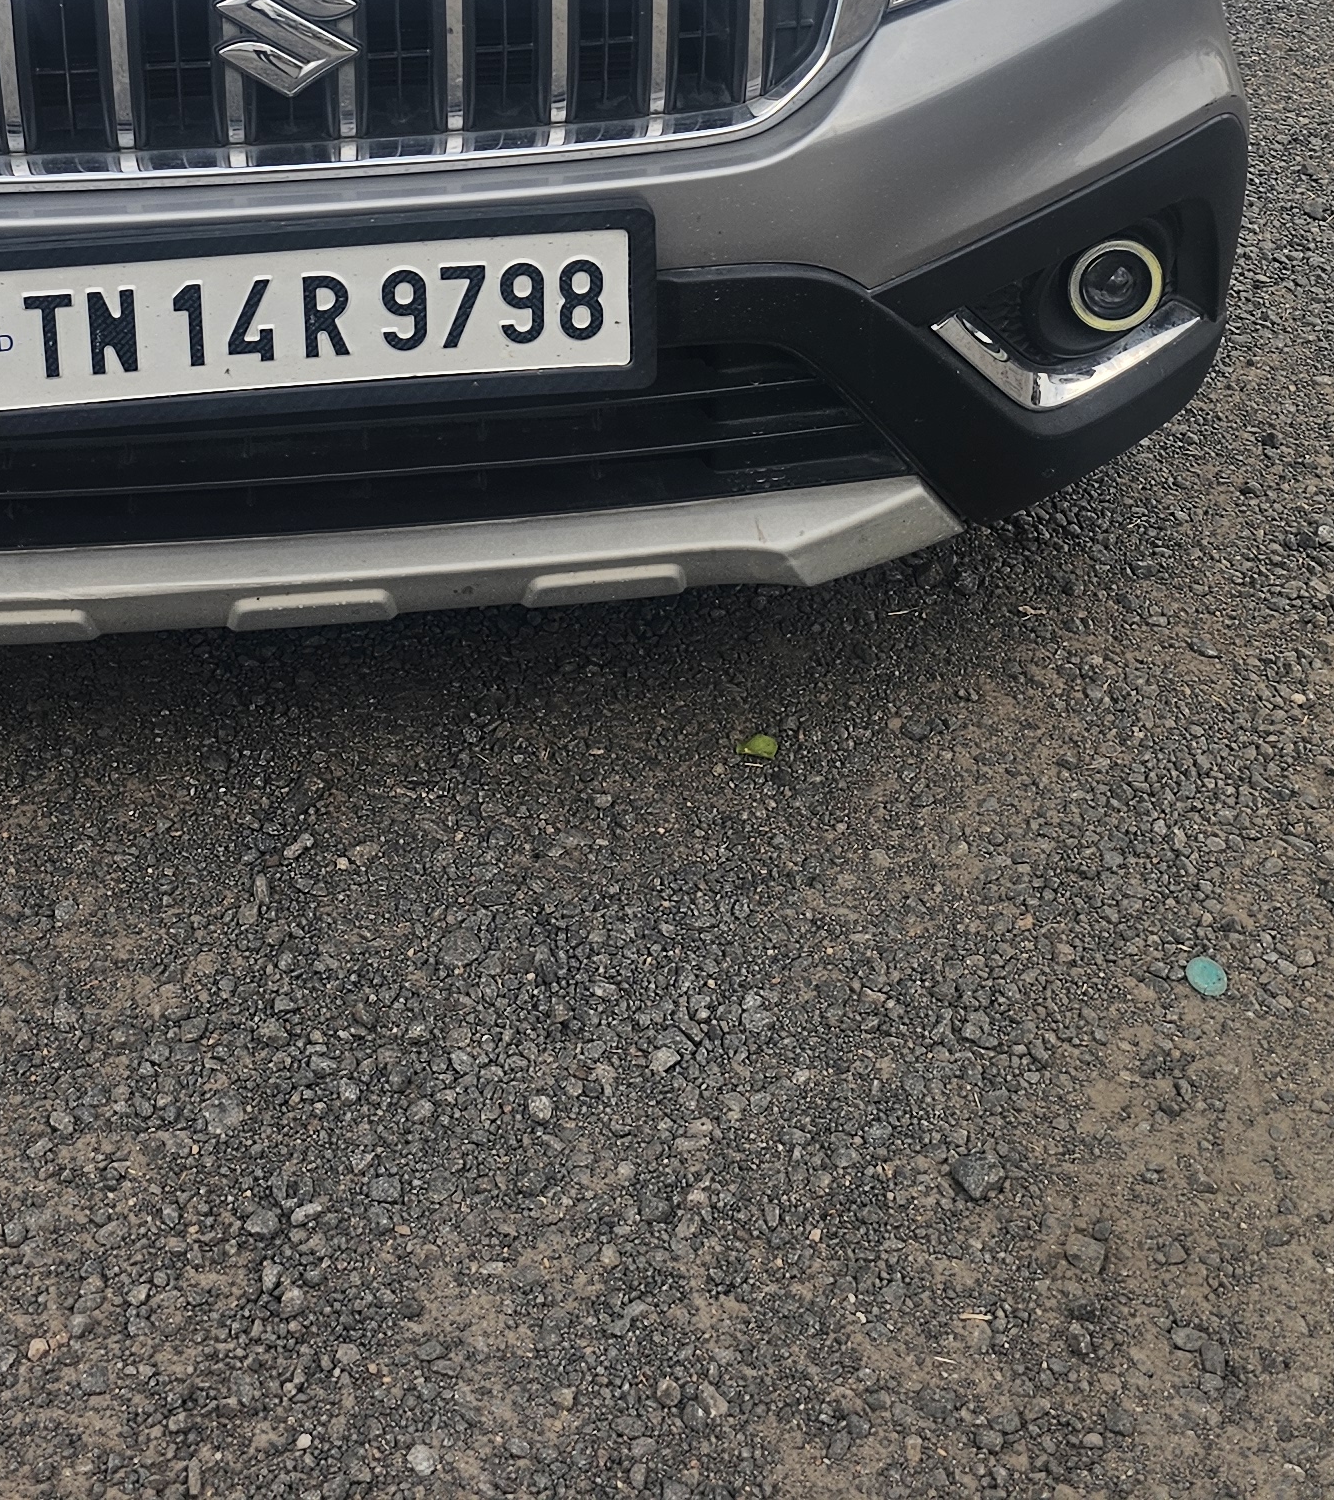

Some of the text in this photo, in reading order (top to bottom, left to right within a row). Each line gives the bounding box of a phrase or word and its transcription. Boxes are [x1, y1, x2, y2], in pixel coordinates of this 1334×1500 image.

[22, 258, 604, 378] TN 14 R 9798
